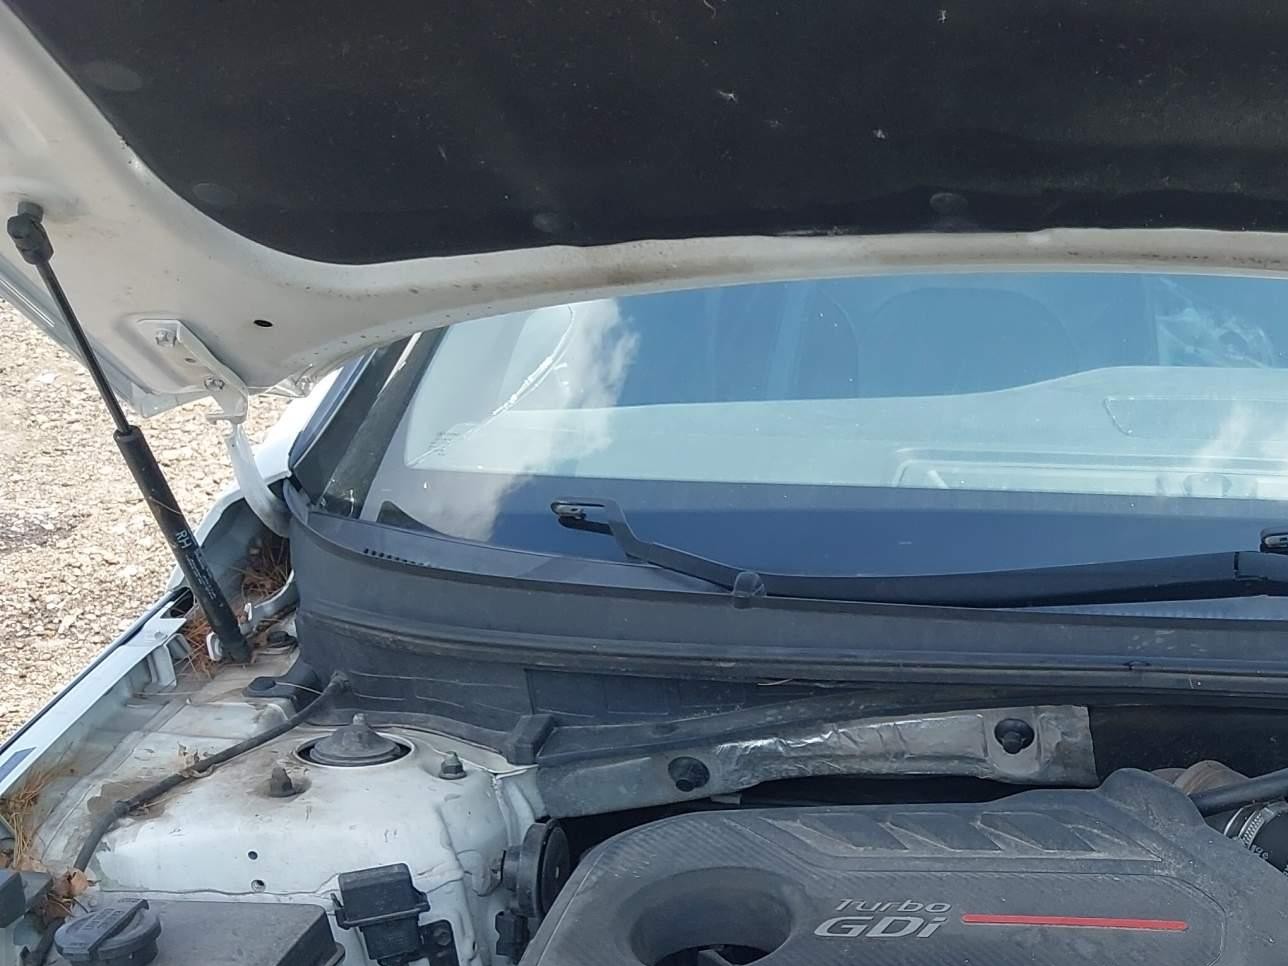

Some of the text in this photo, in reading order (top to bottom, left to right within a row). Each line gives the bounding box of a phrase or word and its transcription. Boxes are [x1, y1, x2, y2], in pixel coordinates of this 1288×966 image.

[175, 529, 193, 549] RH
[835, 898, 952, 913] Turbo
[813, 916, 948, 938] GDi
